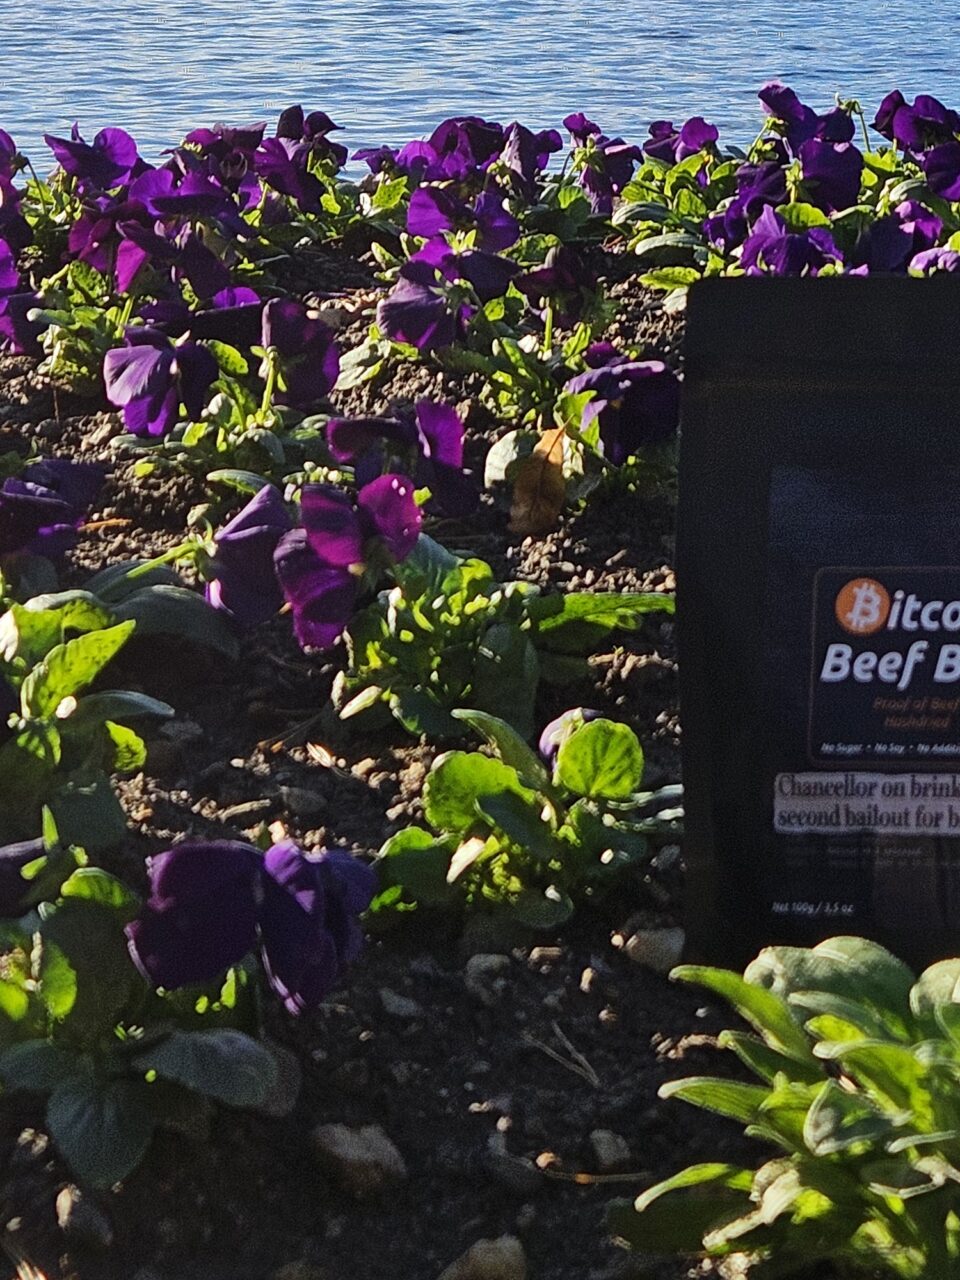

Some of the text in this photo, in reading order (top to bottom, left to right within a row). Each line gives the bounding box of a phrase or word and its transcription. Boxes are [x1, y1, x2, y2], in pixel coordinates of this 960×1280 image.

[820, 640, 929, 692] Beef
[820, 742, 835, 752] No
[874, 742, 887, 753] No
[889, 742, 906, 754] Soy
[917, 743, 929, 753] No
[777, 773, 879, 798] Chancellor
[881, 780, 907, 798] on
[778, 803, 840, 827] second
[844, 803, 910, 827] bailout
[915, 804, 942, 828] for
